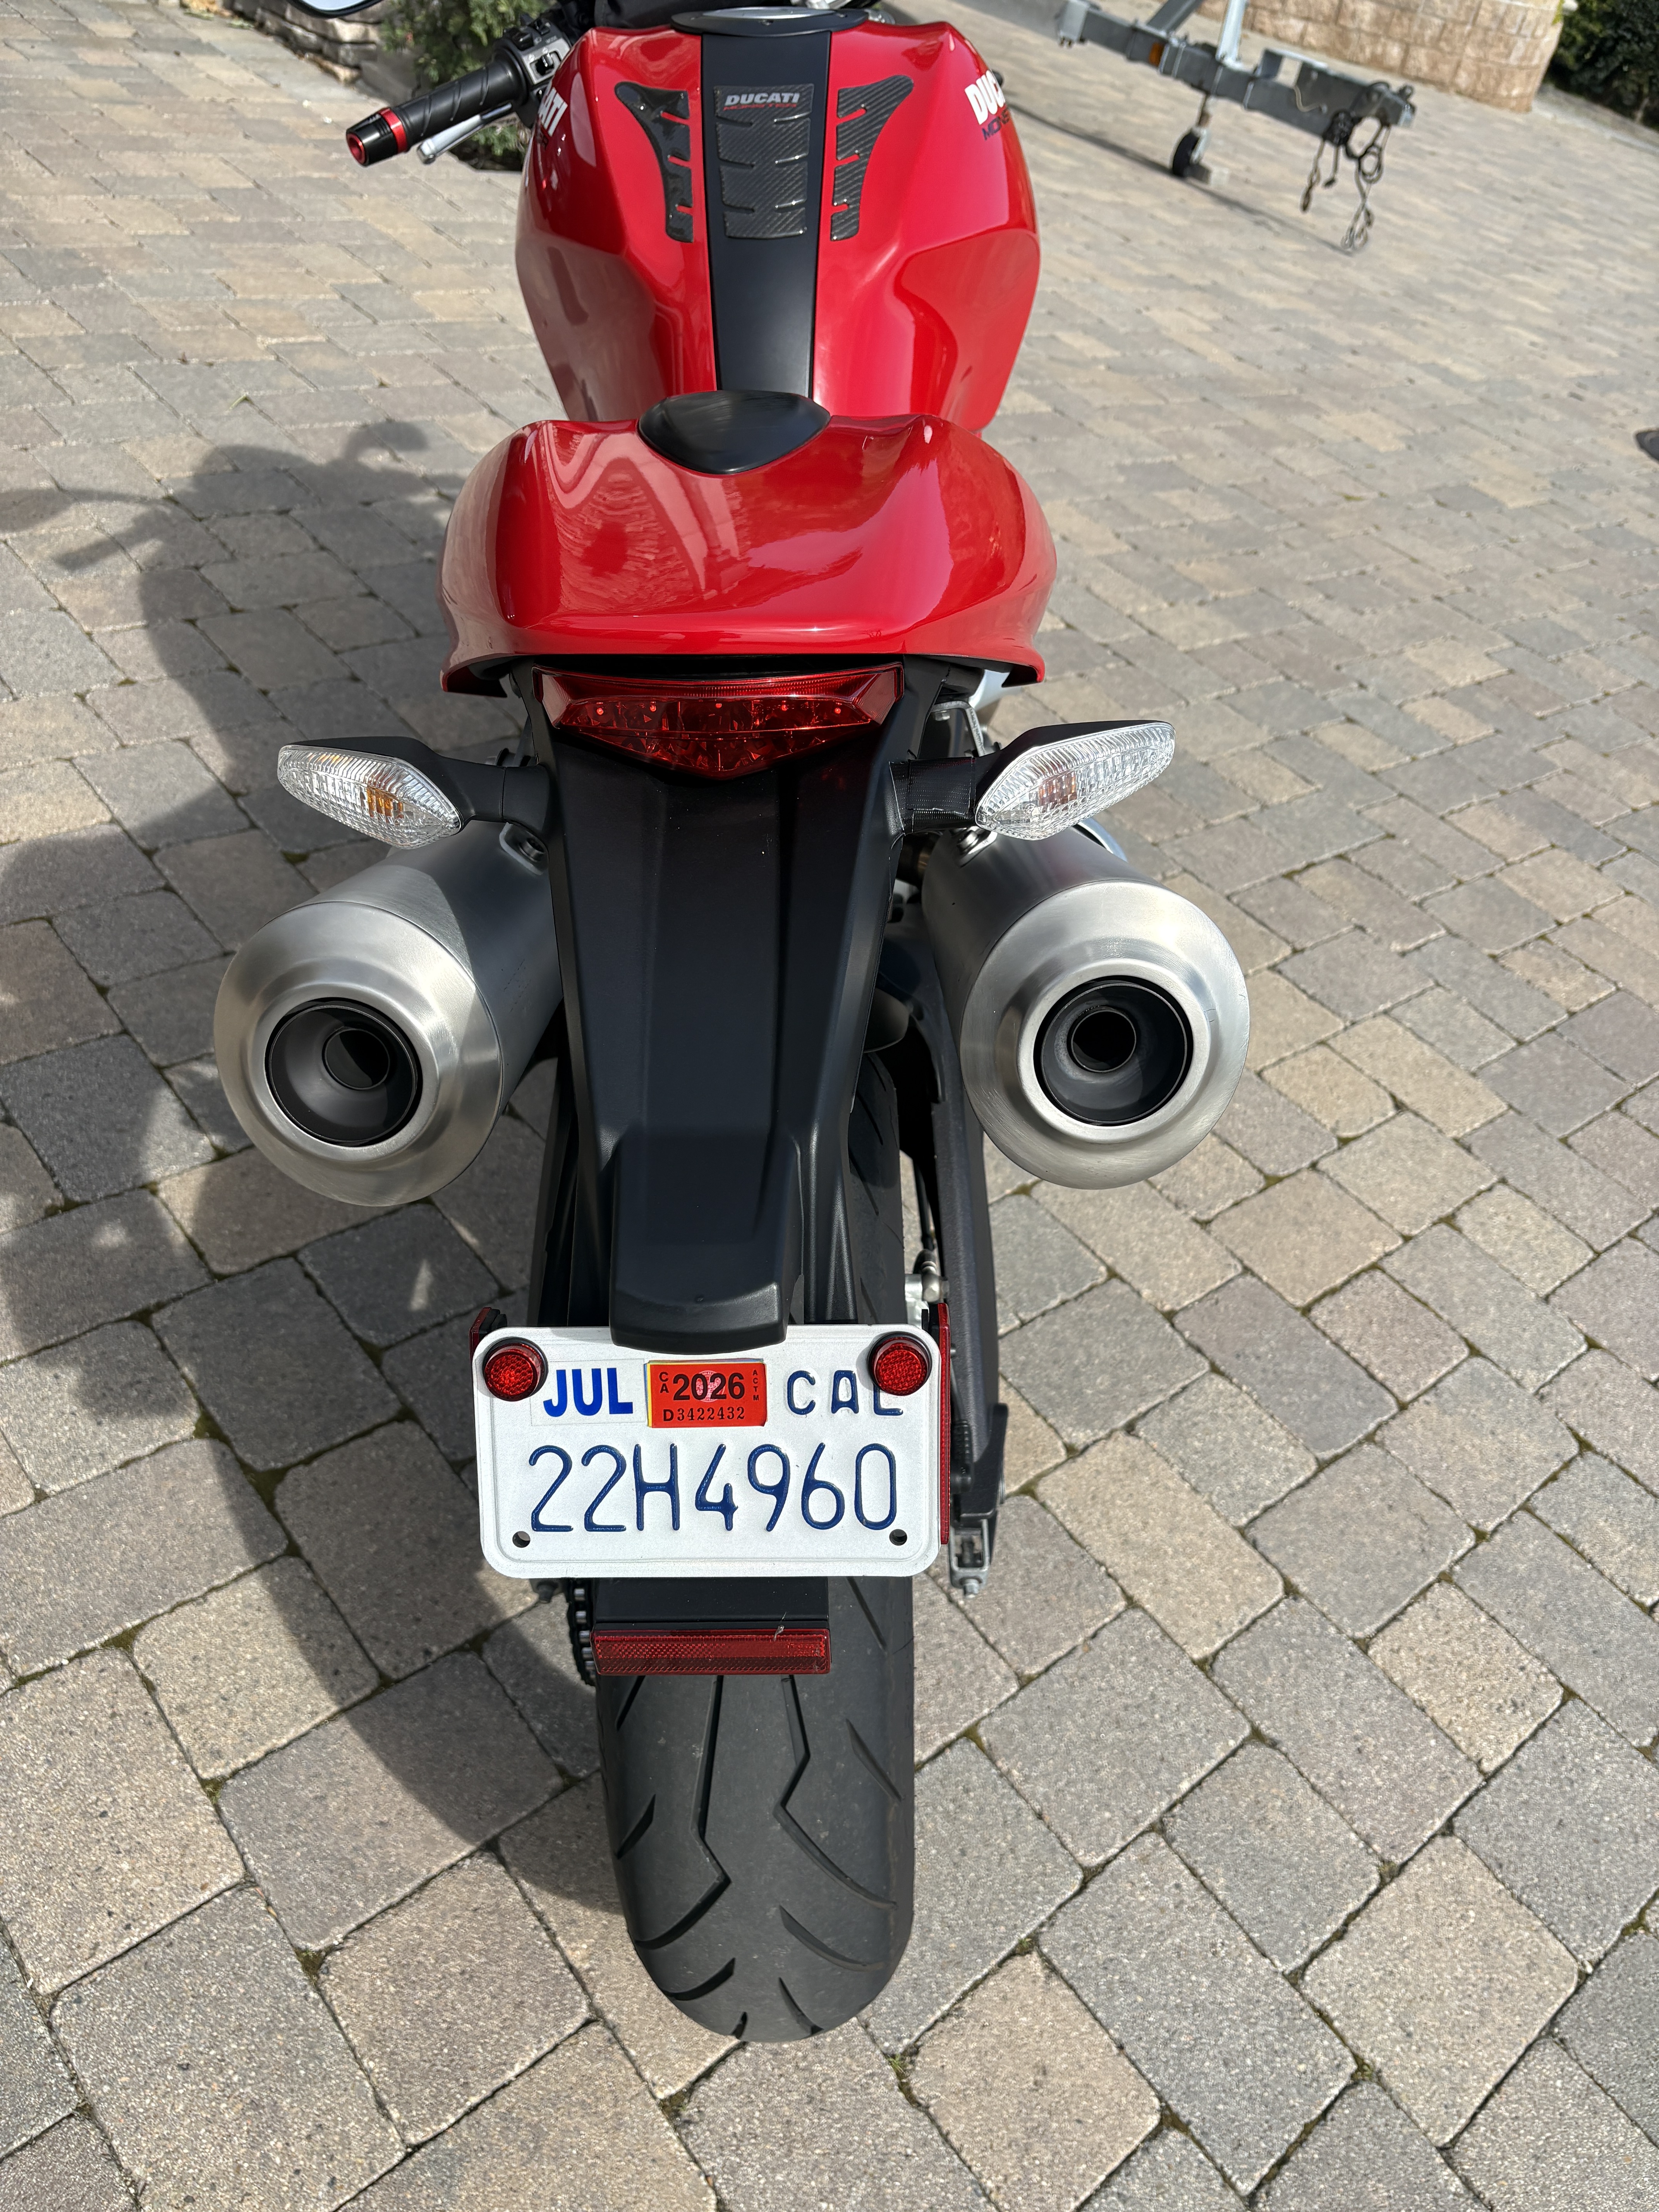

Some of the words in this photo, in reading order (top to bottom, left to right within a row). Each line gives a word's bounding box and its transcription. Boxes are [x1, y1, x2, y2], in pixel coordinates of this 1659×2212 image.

[725, 93, 800, 106] DUCATI
[543, 1367, 634, 1417] JUL
[673, 1373, 745, 1401] 2026
[787, 1370, 904, 1416] CAL
[529, 1443, 897, 1532] 22H4960
